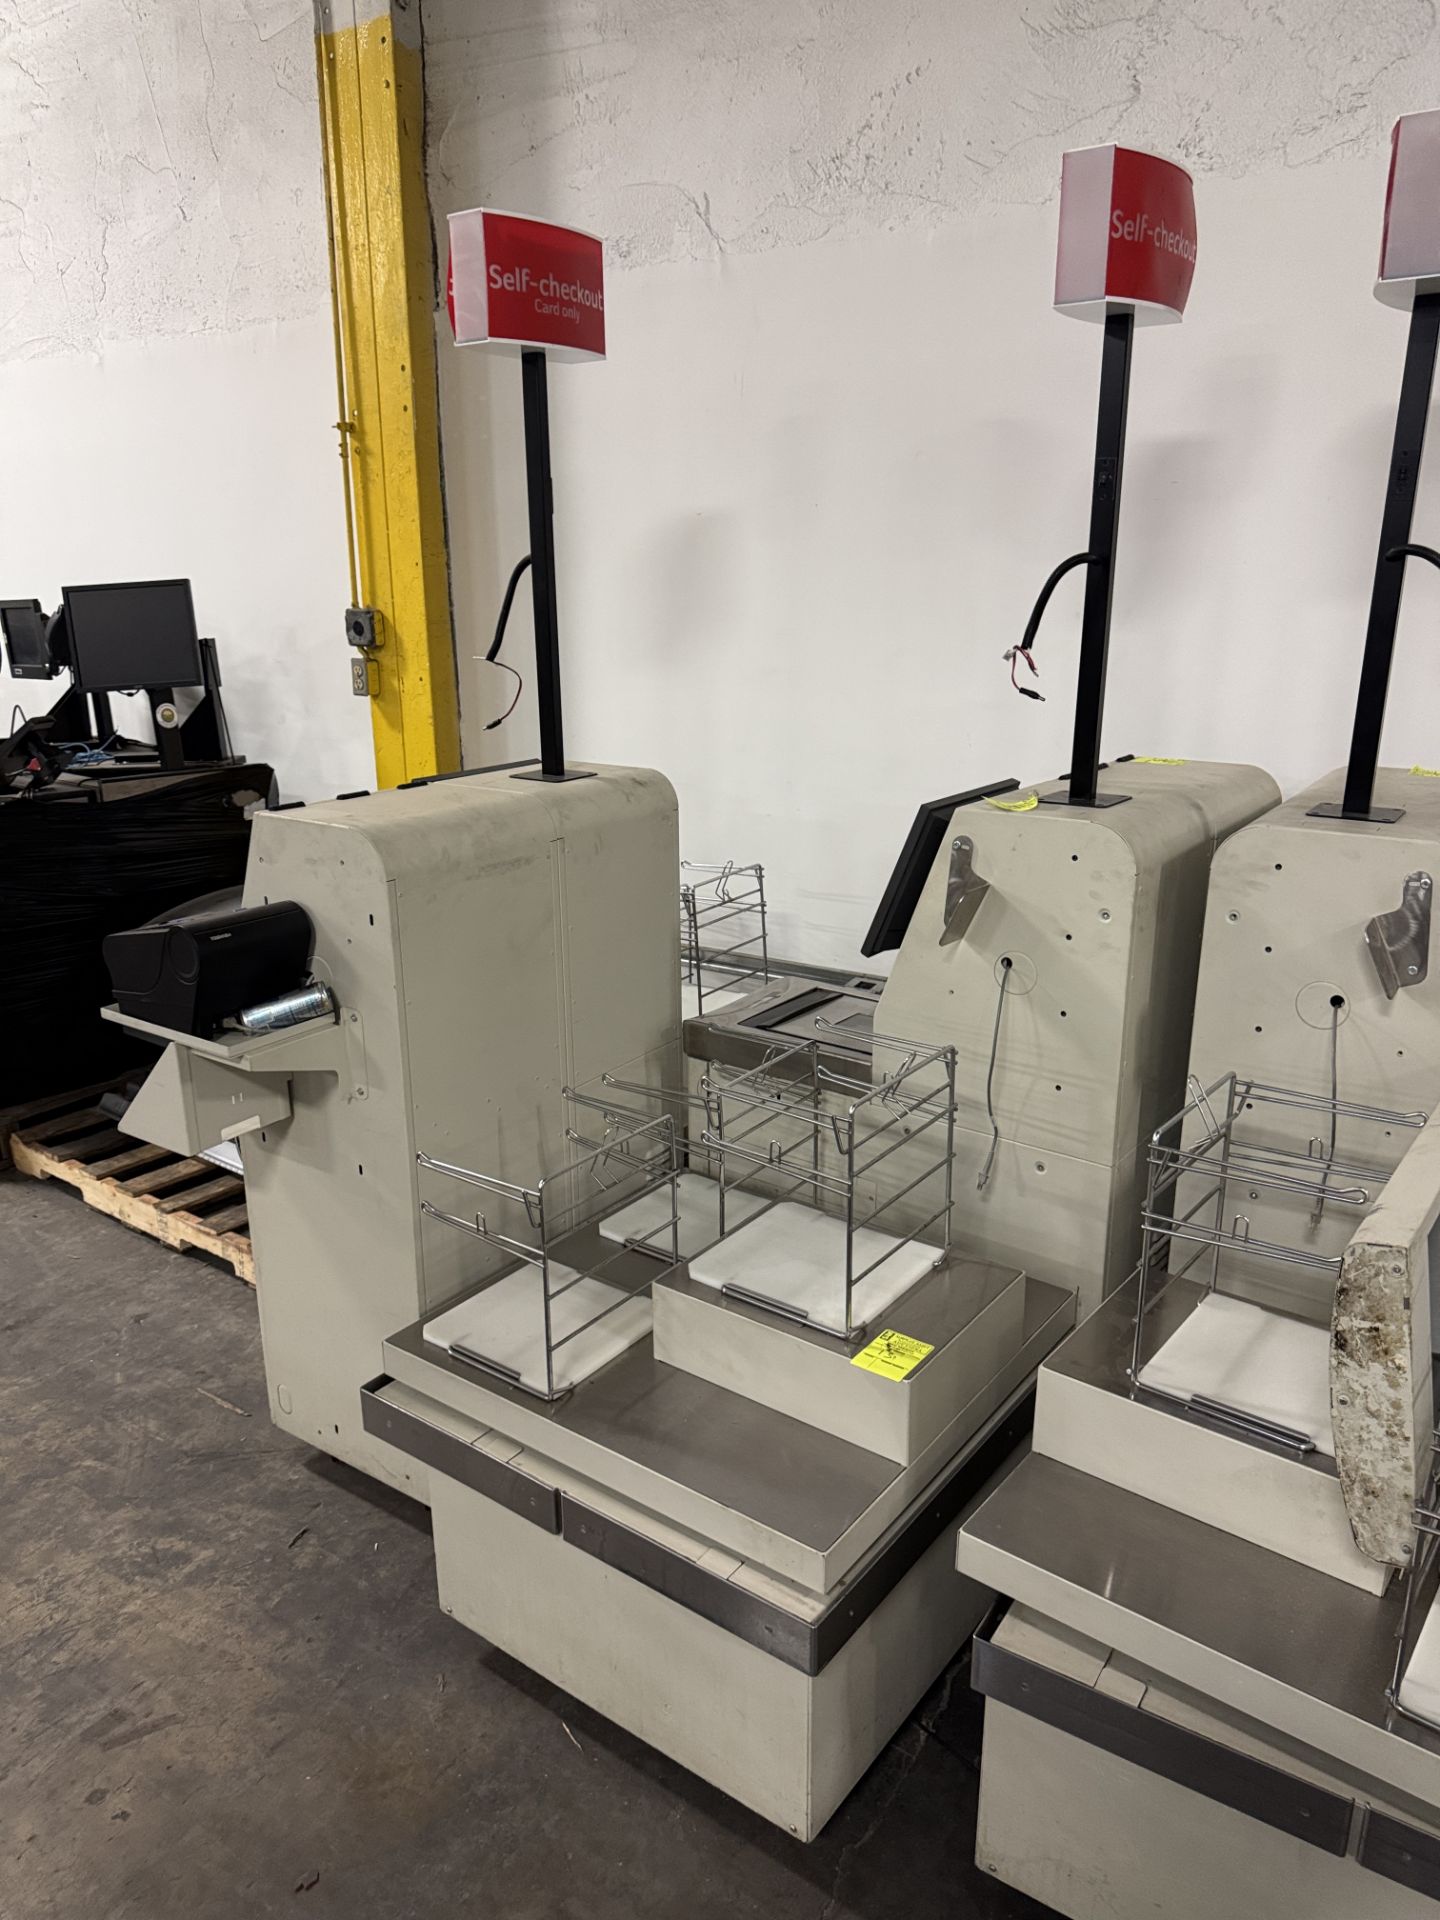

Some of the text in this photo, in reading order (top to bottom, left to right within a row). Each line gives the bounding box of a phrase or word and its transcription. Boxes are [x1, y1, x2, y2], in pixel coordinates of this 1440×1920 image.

[1111, 210, 1196, 263] Self-checkout
[489, 265, 604, 310] Self-checkout
[534, 299, 581, 324] Card only
